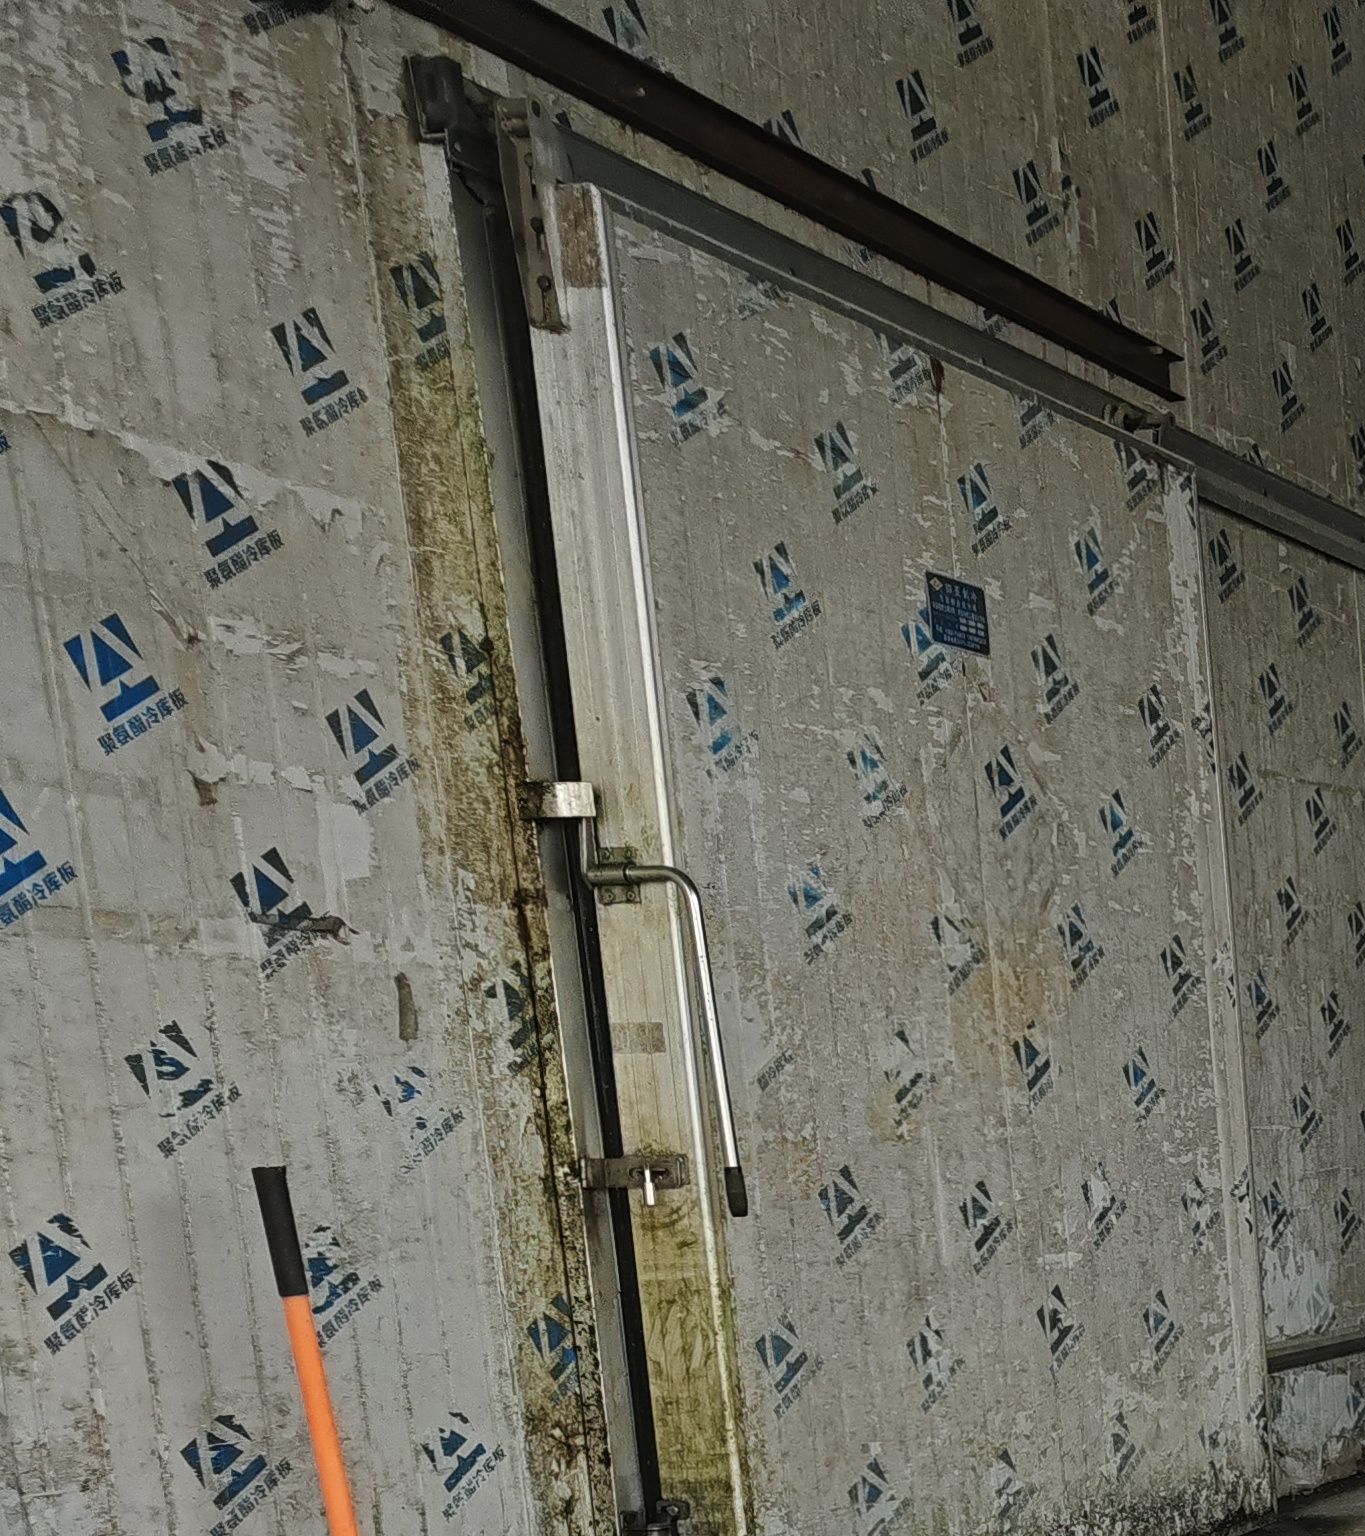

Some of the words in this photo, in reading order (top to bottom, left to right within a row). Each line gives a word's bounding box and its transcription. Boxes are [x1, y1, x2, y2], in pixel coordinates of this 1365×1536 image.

[204, 529, 284, 590] 聚氨酯冷库板
[97, 687, 189, 755] 聚氨酯冷库板
[43, 1272, 136, 1355] 聚氨酯冷库板
